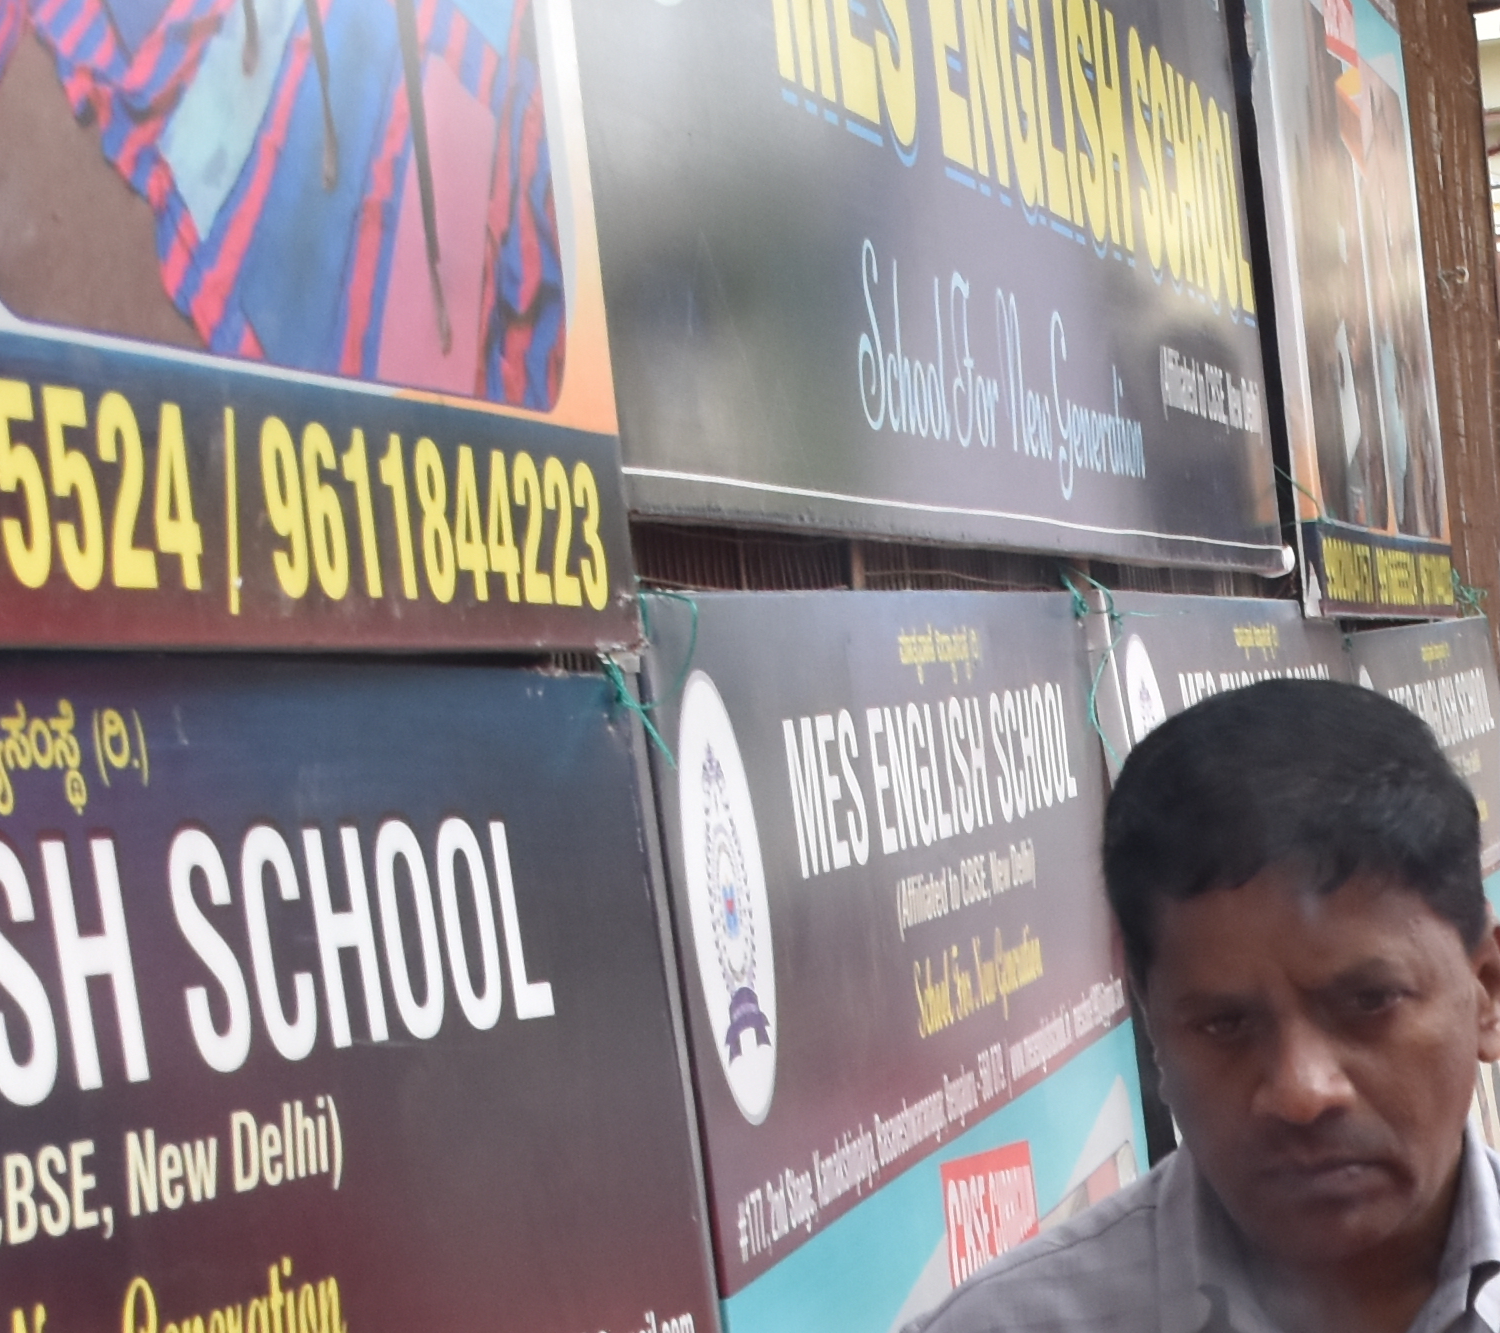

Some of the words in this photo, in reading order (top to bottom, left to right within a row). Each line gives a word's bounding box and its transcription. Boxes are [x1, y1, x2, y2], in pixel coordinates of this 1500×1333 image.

[1129, 27, 1255, 315] SCHOOL
[857, 237, 951, 441] School
[950, 270, 1000, 449] For
[259, 414, 608, 612] 9611844223
[781, 708, 870, 880] MES
[866, 695, 994, 856] ENGLISH
[989, 681, 1078, 824] SCHOOL
[167, 816, 557, 1074] SCHOOL
[126, 1129, 219, 1218] New
[232, 1094, 344, 1193] Delhi)
